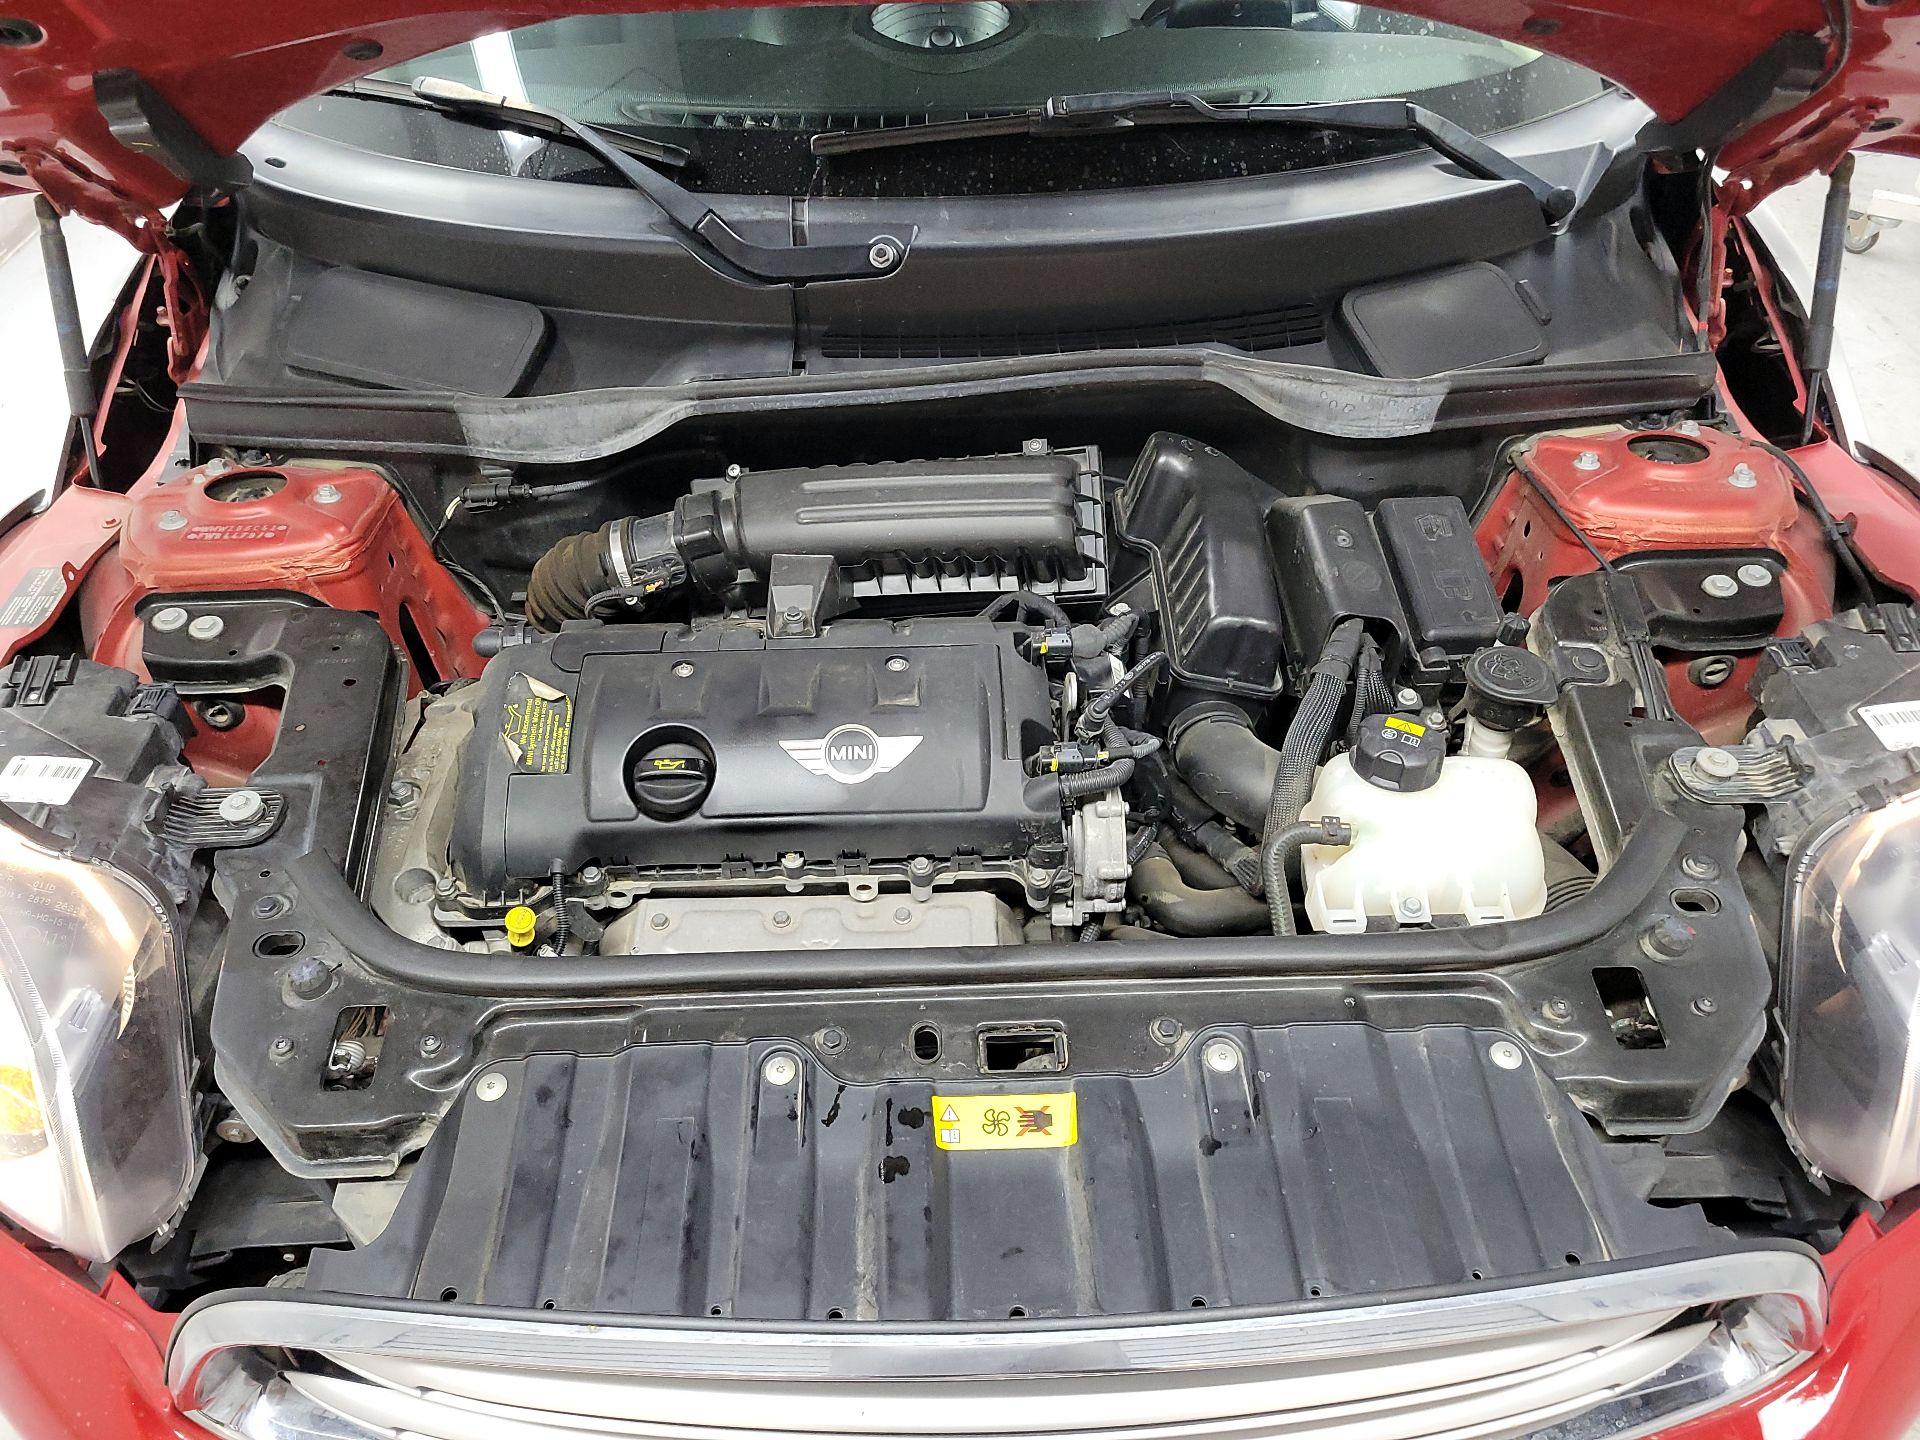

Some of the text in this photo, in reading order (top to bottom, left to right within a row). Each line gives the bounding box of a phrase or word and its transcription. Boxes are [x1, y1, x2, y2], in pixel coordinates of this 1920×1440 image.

[519, 698, 533, 745] We Recommend
[532, 705, 540, 724] Motor
[528, 723, 538, 750] Synthetic
[525, 750, 534, 766] MINI
[830, 744, 873, 761] MINI
